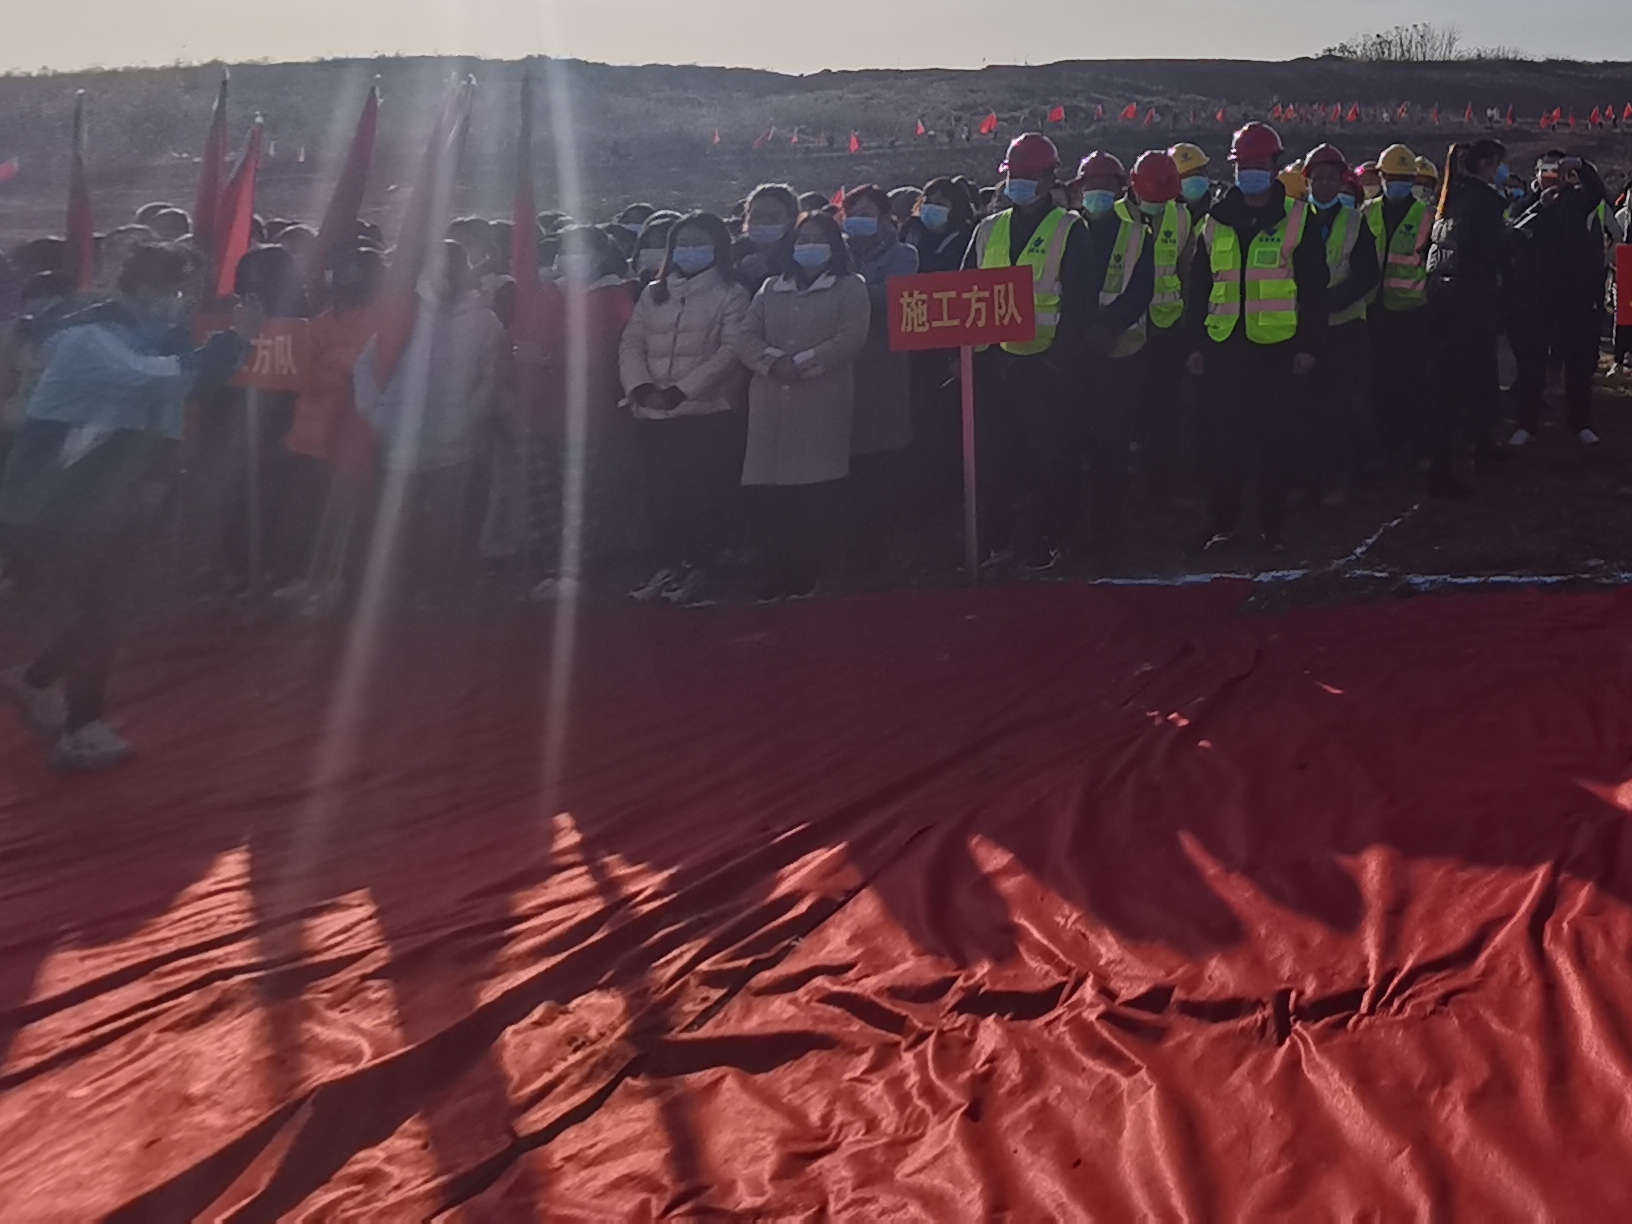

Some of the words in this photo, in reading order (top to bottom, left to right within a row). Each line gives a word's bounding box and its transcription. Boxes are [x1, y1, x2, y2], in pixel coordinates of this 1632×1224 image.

[900, 282, 1022, 333] 施工方队
[238, 333, 297, 375] 方队
